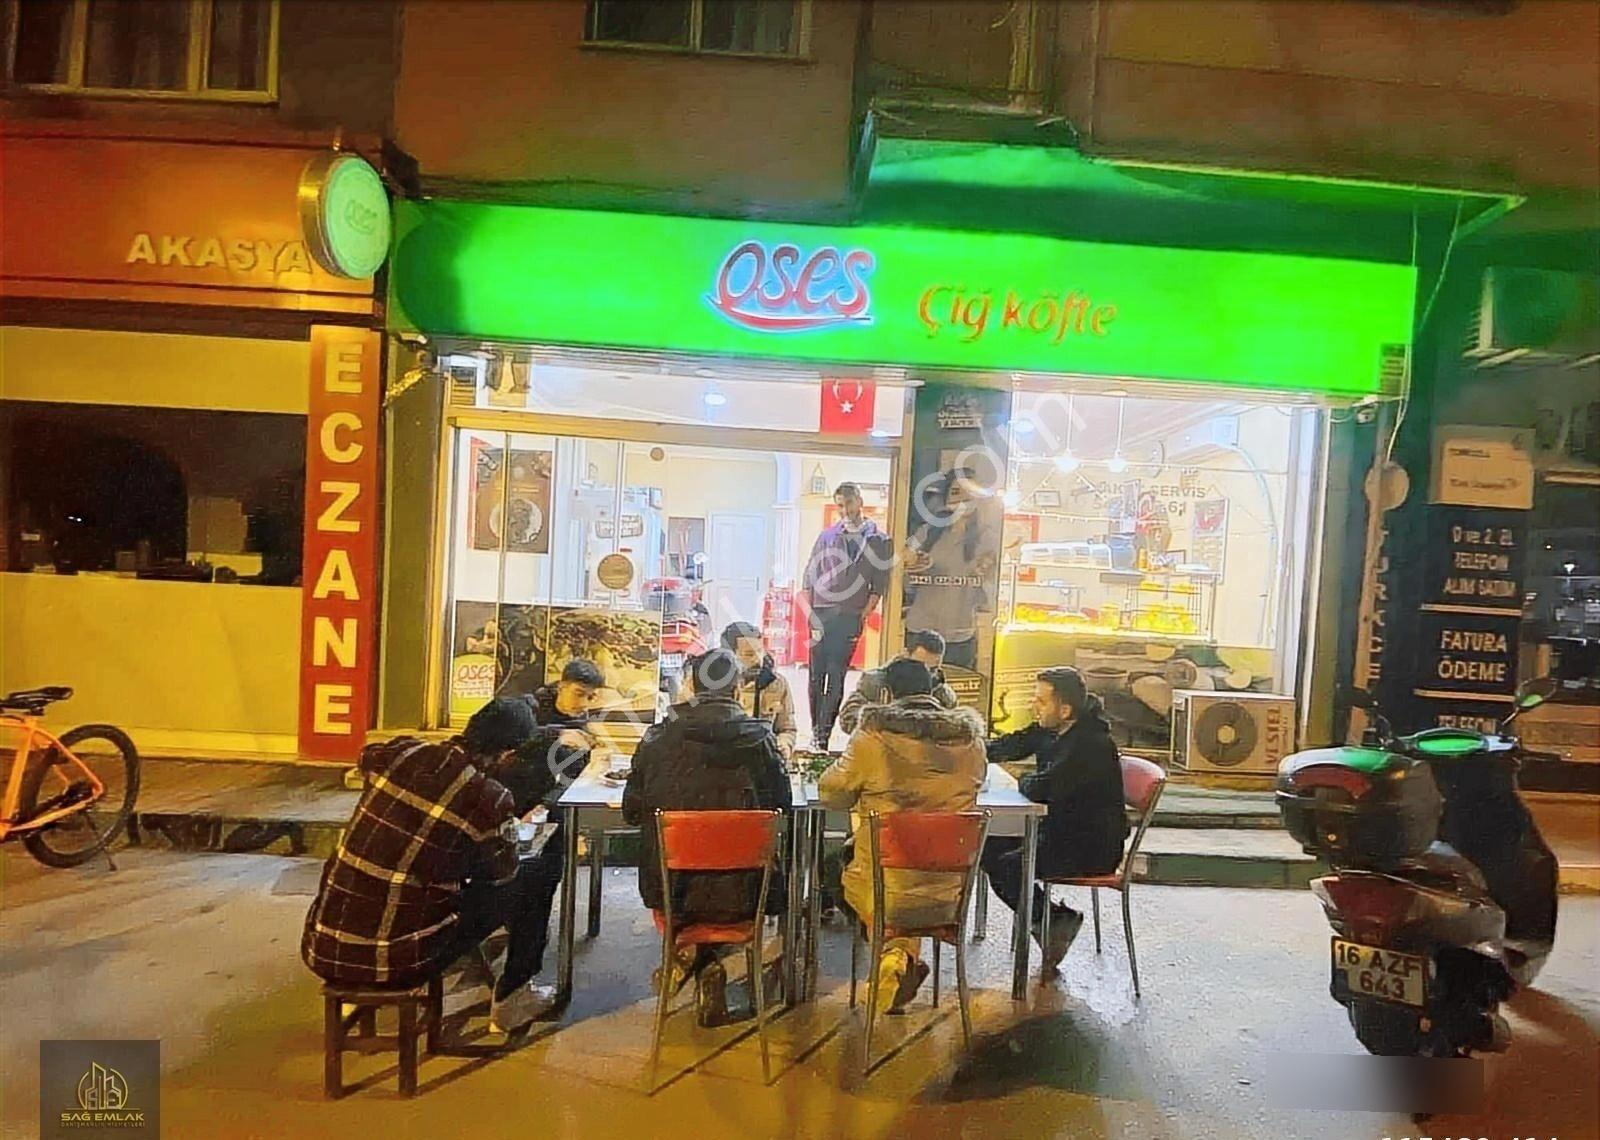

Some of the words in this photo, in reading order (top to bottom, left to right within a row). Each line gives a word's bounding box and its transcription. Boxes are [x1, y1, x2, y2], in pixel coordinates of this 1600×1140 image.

[127, 233, 313, 275] AKASYA
[919, 283, 993, 344] Çiğ
[1002, 287, 1118, 347] köfte
[312, 342, 364, 735] ECZANE
[1454, 551, 1510, 571] TELEFON
[1440, 630, 1508, 653] FATURA
[1438, 654, 1507, 682] ÖDEME
[1337, 943, 1361, 967] 16
[1370, 950, 1422, 979] AZF
[1360, 970, 1405, 999] 643
